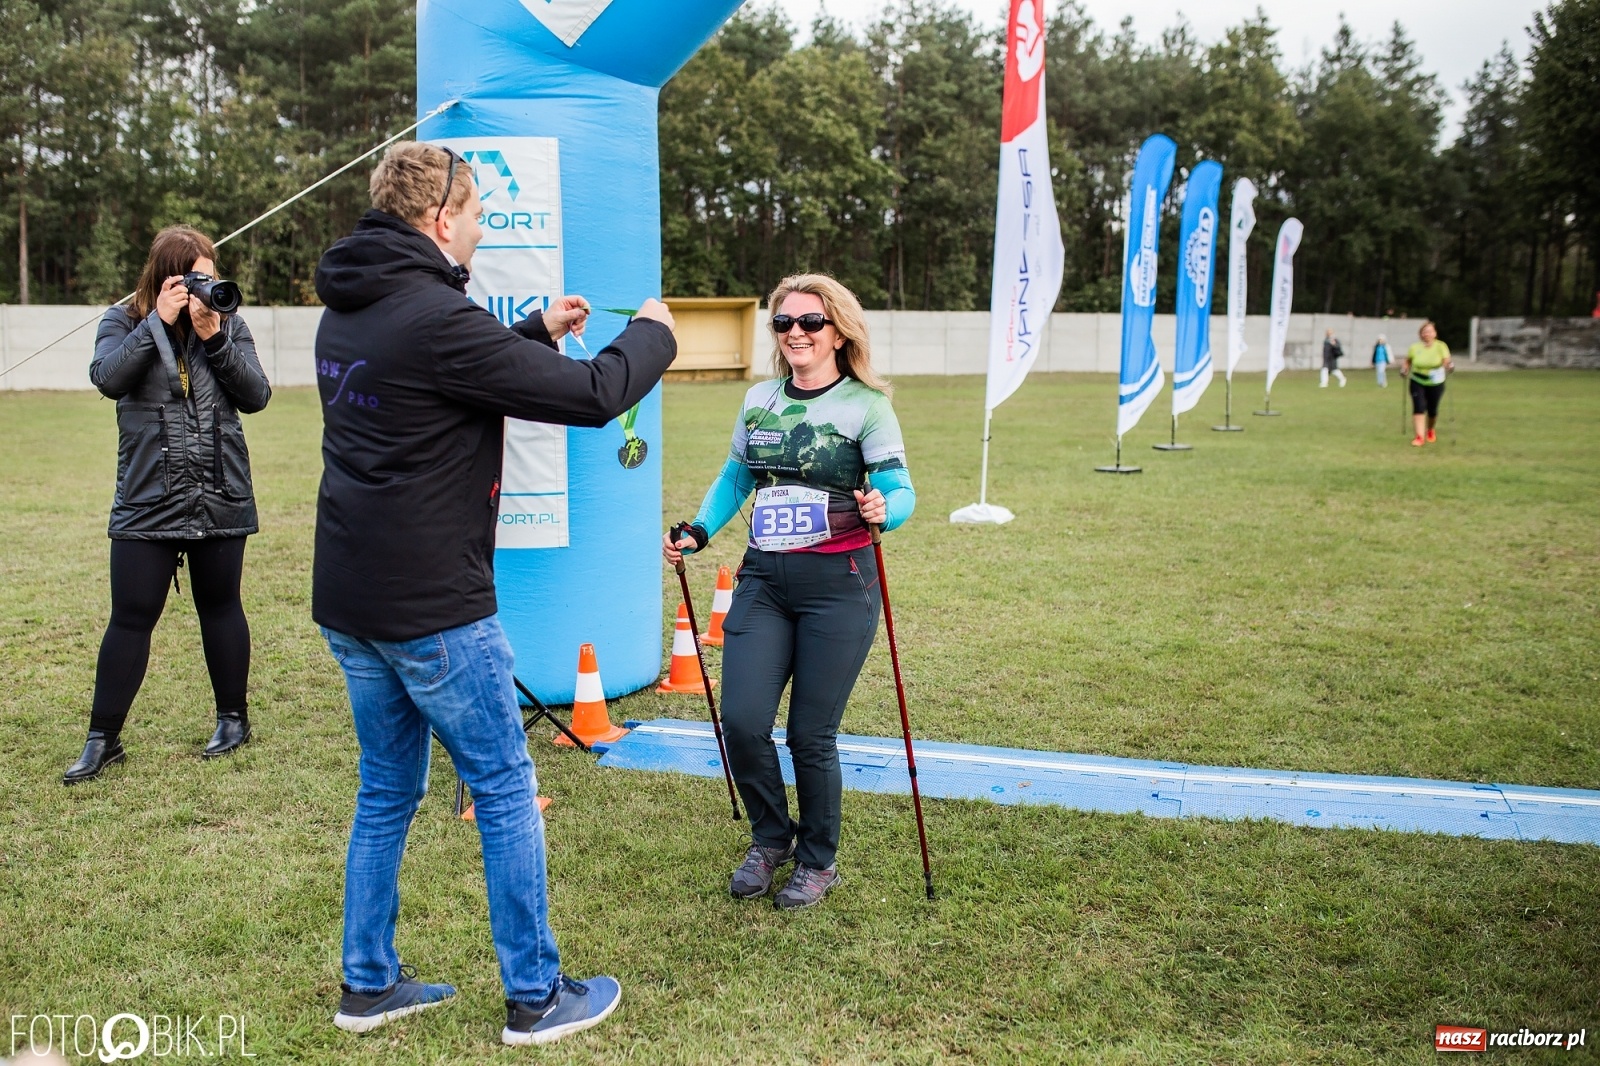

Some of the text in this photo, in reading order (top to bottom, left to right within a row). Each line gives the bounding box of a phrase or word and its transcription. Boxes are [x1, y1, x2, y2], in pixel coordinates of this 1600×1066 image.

[348, 390, 379, 408] PRO
[771, 489, 789, 498] DYSZKA
[762, 506, 813, 535] 335
